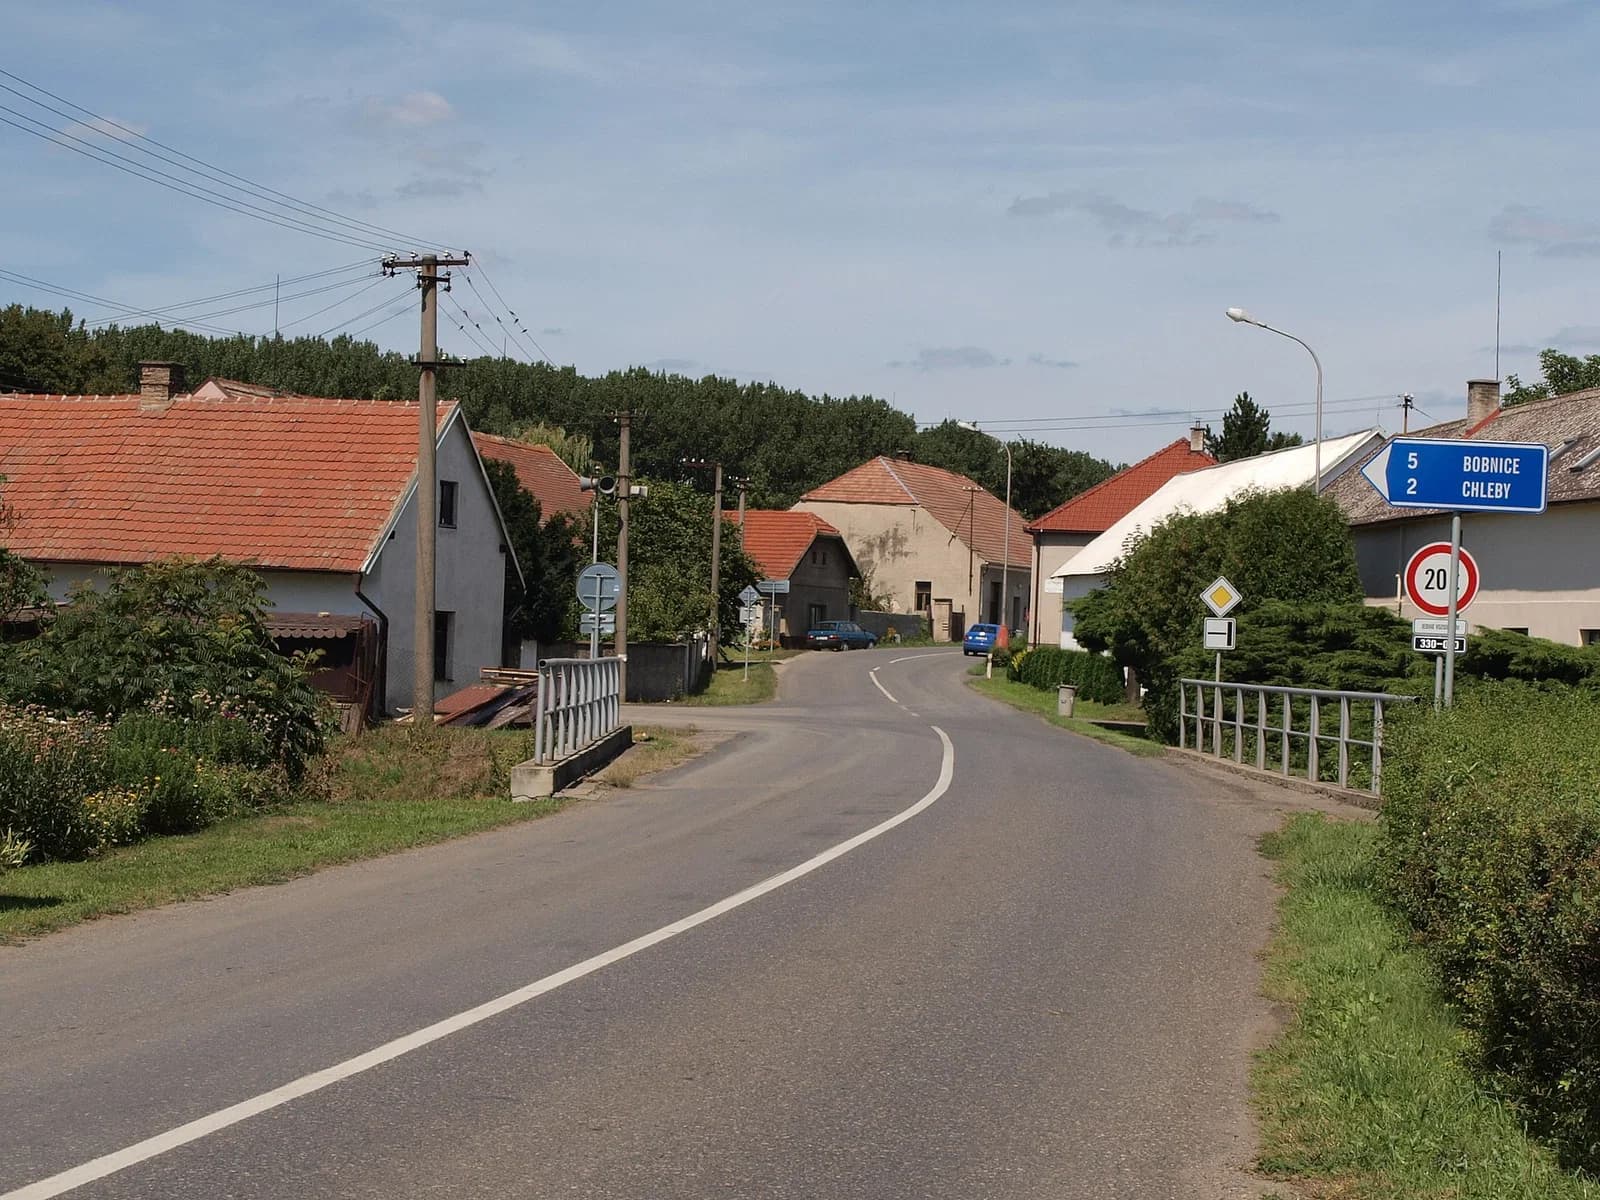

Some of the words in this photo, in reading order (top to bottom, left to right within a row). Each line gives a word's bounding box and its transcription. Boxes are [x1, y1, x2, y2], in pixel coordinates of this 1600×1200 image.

[1407, 452, 1418, 469] 5
[1463, 456, 1521, 474] BOBNICE
[1406, 477, 1417, 495] 2
[1462, 481, 1511, 499] CHLEBY
[1424, 568, 1447, 590] 20
[1419, 638, 1460, 650] 330-00
